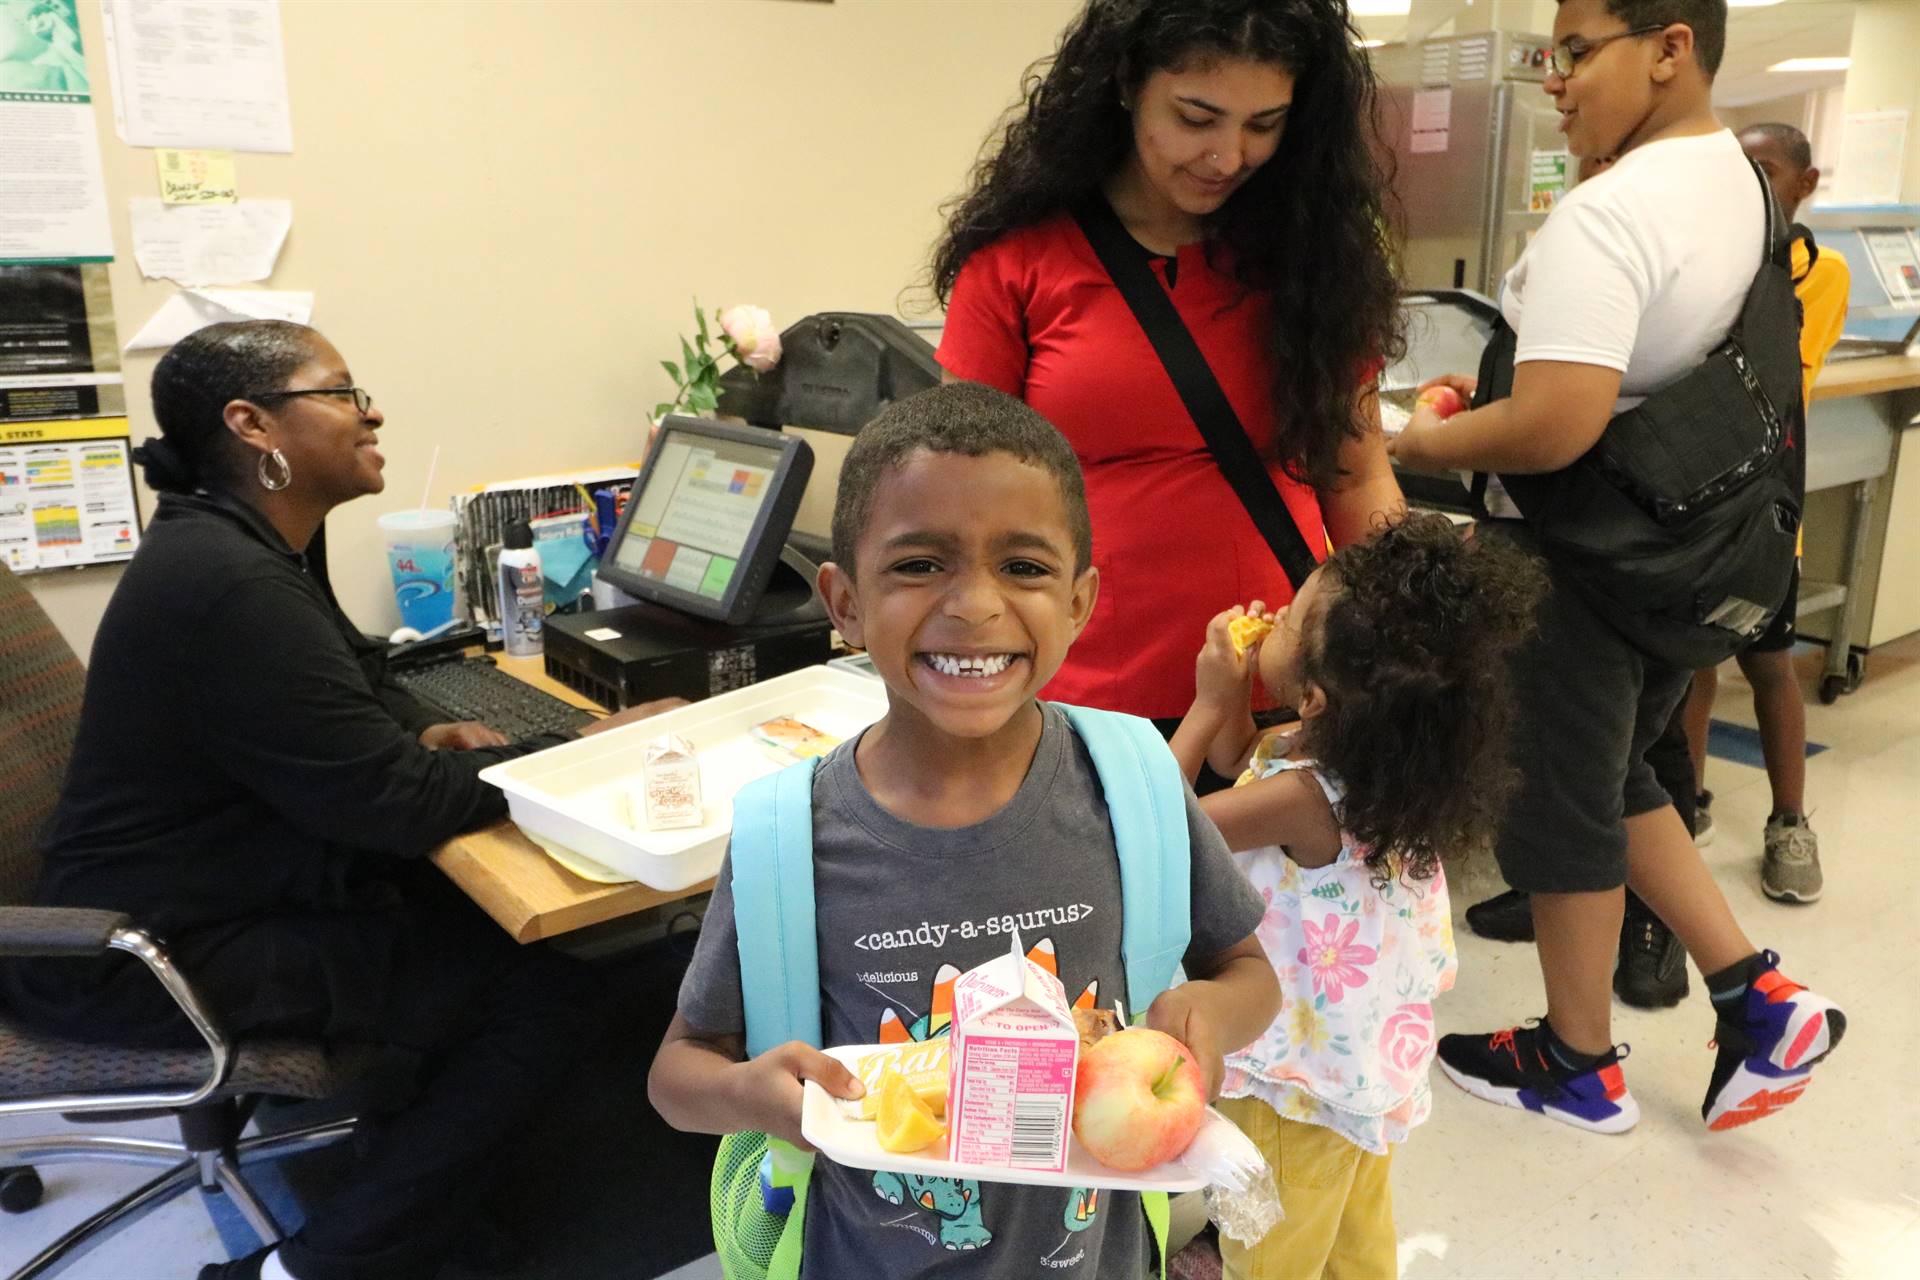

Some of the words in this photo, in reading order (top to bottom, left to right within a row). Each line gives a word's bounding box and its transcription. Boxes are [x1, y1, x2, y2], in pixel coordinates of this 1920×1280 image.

[6, 430, 44, 440] STATS
[854, 903, 1094, 951] <candy-a-saurus>
[1016, 1023, 1049, 1032] OPEN
